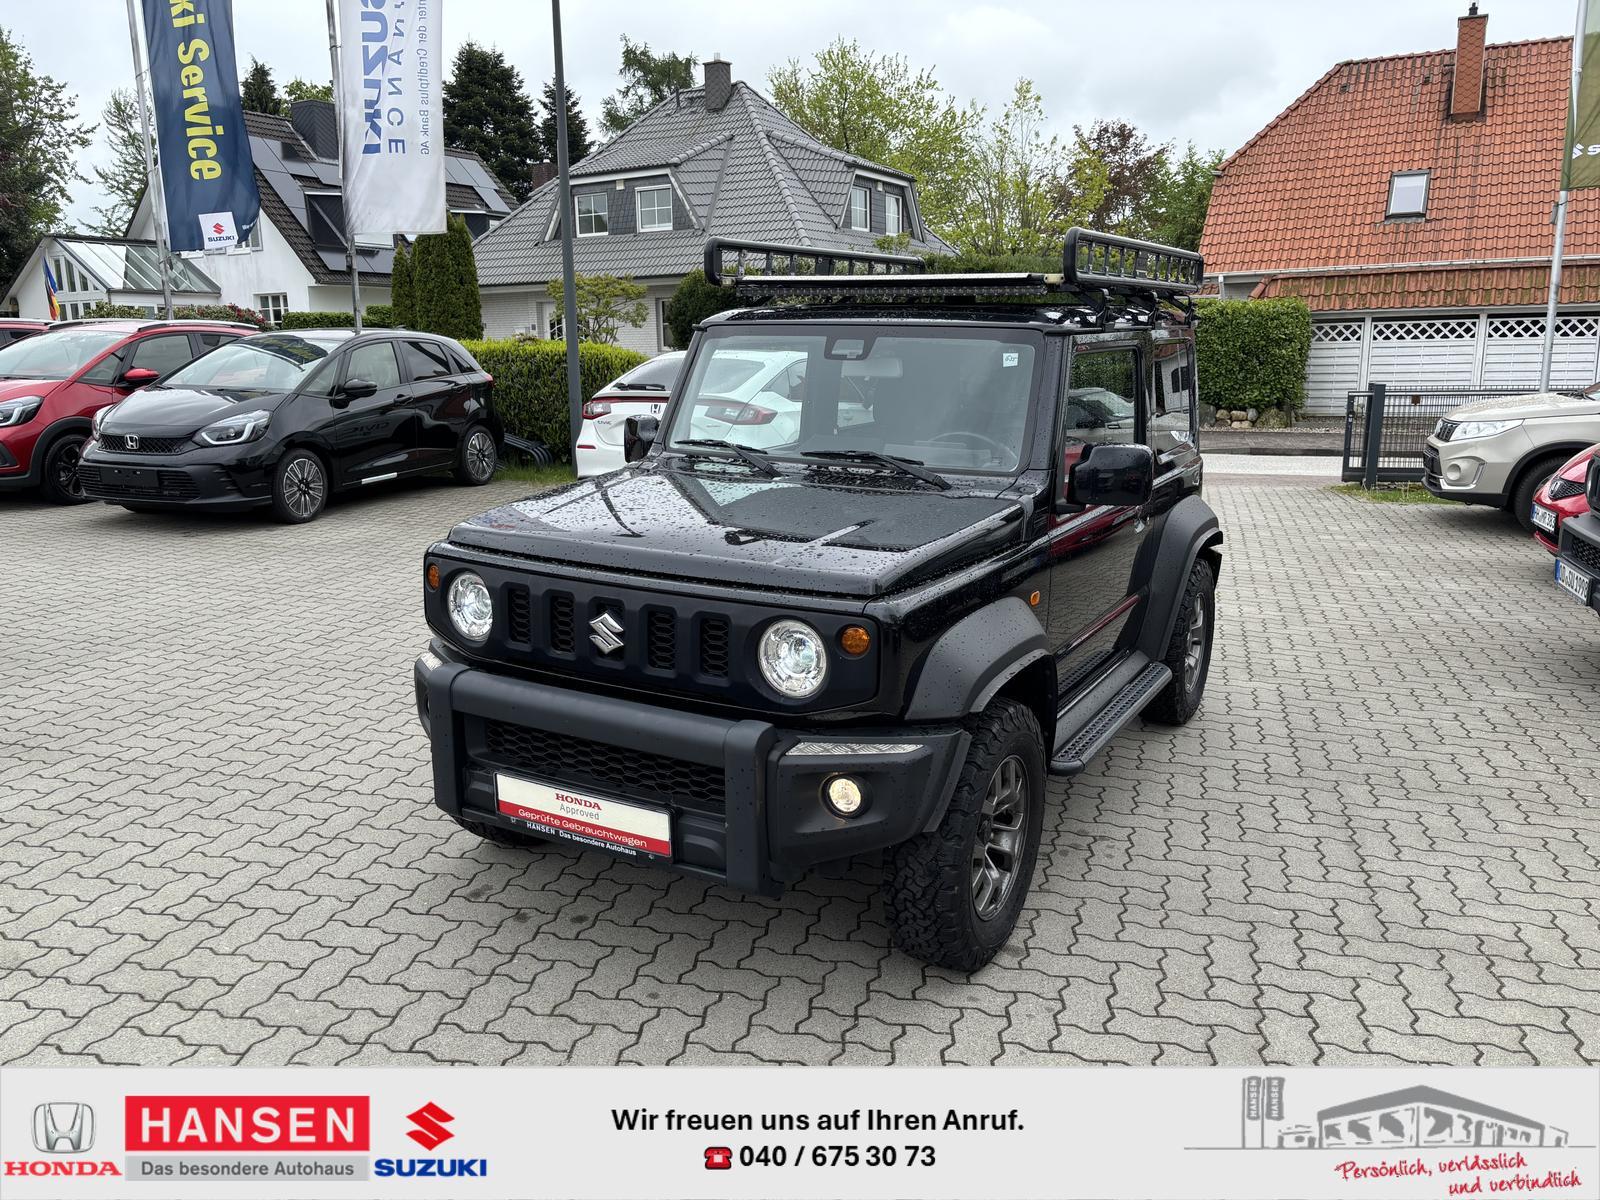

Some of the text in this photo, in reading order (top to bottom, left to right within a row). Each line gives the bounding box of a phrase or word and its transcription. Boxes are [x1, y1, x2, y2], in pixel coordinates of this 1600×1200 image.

[177, 38, 225, 181] Service
[555, 792, 602, 811] HONDA
[559, 803, 600, 821] Approved
[518, 808, 647, 848] Geprüfte Gebrauchtwagen
[526, 821, 637, 856] HANSEN Das besondere Autohaus
